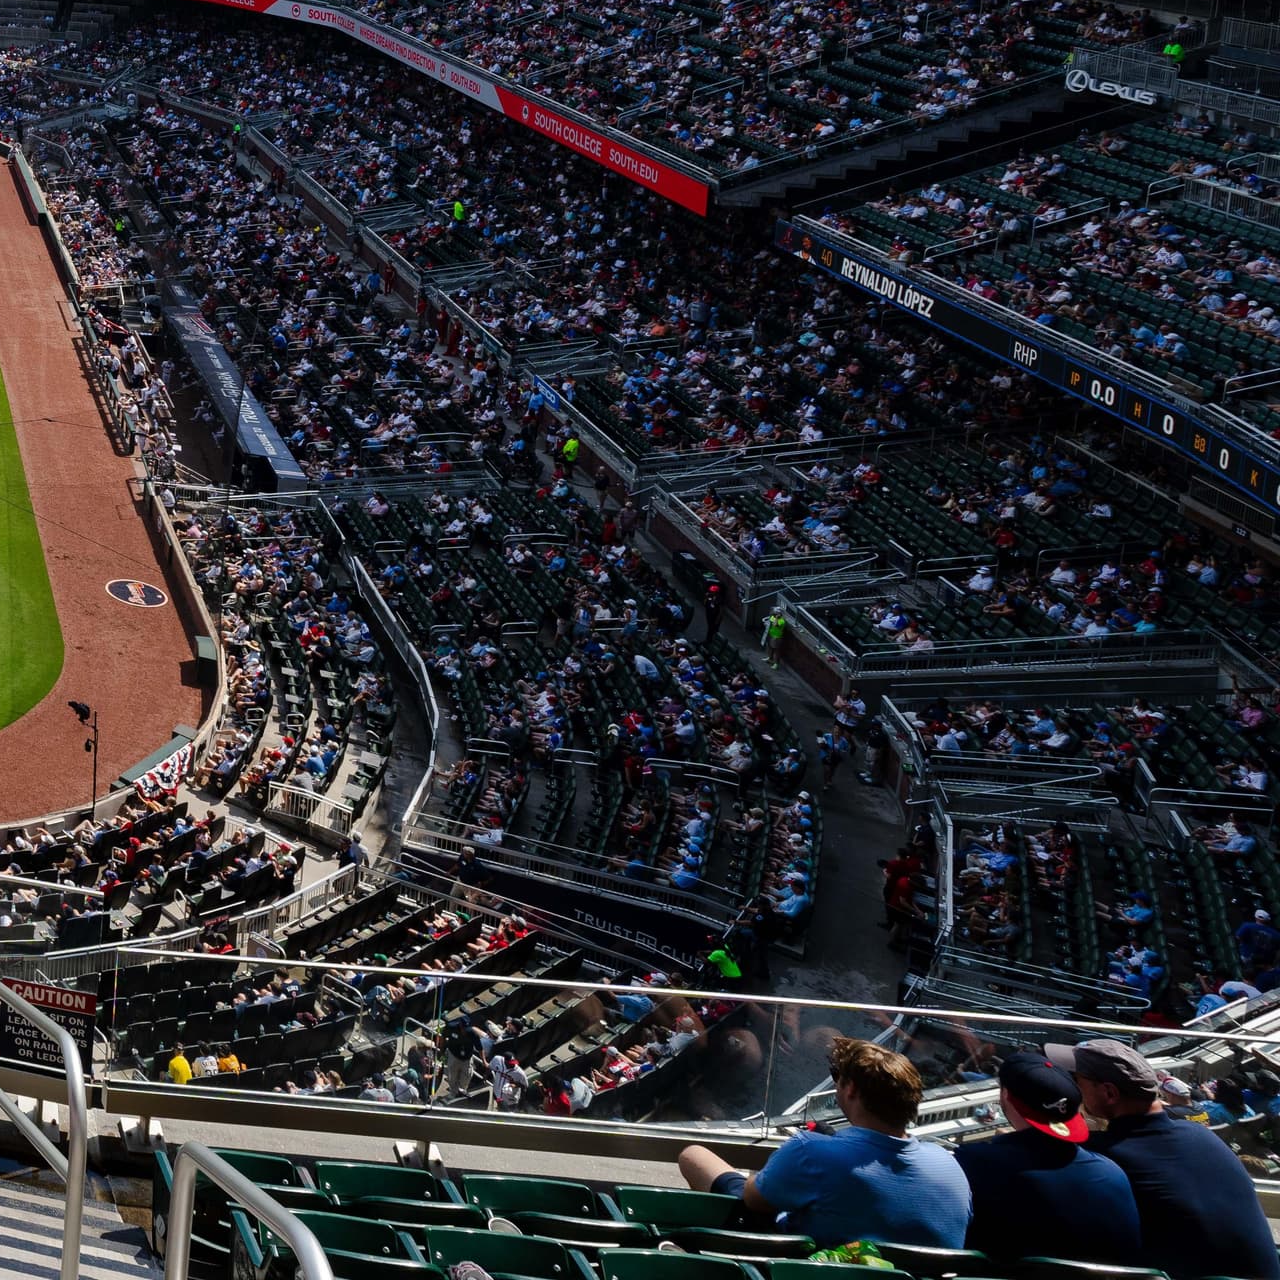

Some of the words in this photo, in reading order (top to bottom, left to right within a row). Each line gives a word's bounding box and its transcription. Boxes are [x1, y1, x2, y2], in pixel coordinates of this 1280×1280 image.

[307, 8, 337, 23] SOUTH
[450, 71, 481, 96] SOUTH.EDU
[1089, 77, 1157, 105] LEXUS
[534, 111, 563, 138] SOUTH
[563, 123, 602, 158] COLLEGE
[609, 150, 659, 185] SOUTH.EDU
[820, 248, 833, 267] 40
[841, 257, 896, 306] REYNALDO
[896, 279, 935, 319] LÓPEZ
[1013, 340, 1038, 367] RHP
[1071, 371, 1080, 387] IP
[1091, 379, 1115, 406] 0.0
[1133, 401, 1141, 418] H
[1162, 414, 1174, 436] 0
[1194, 434, 1206, 453] BB
[1218, 447, 1230, 470] 0
[1250, 469, 1259, 488] K
[11, 984, 87, 1010] CAUTION
[5, 1025, 39, 1039] PLACE
[14, 1037, 31, 1047] ON
[18, 1048, 34, 1058] OR
